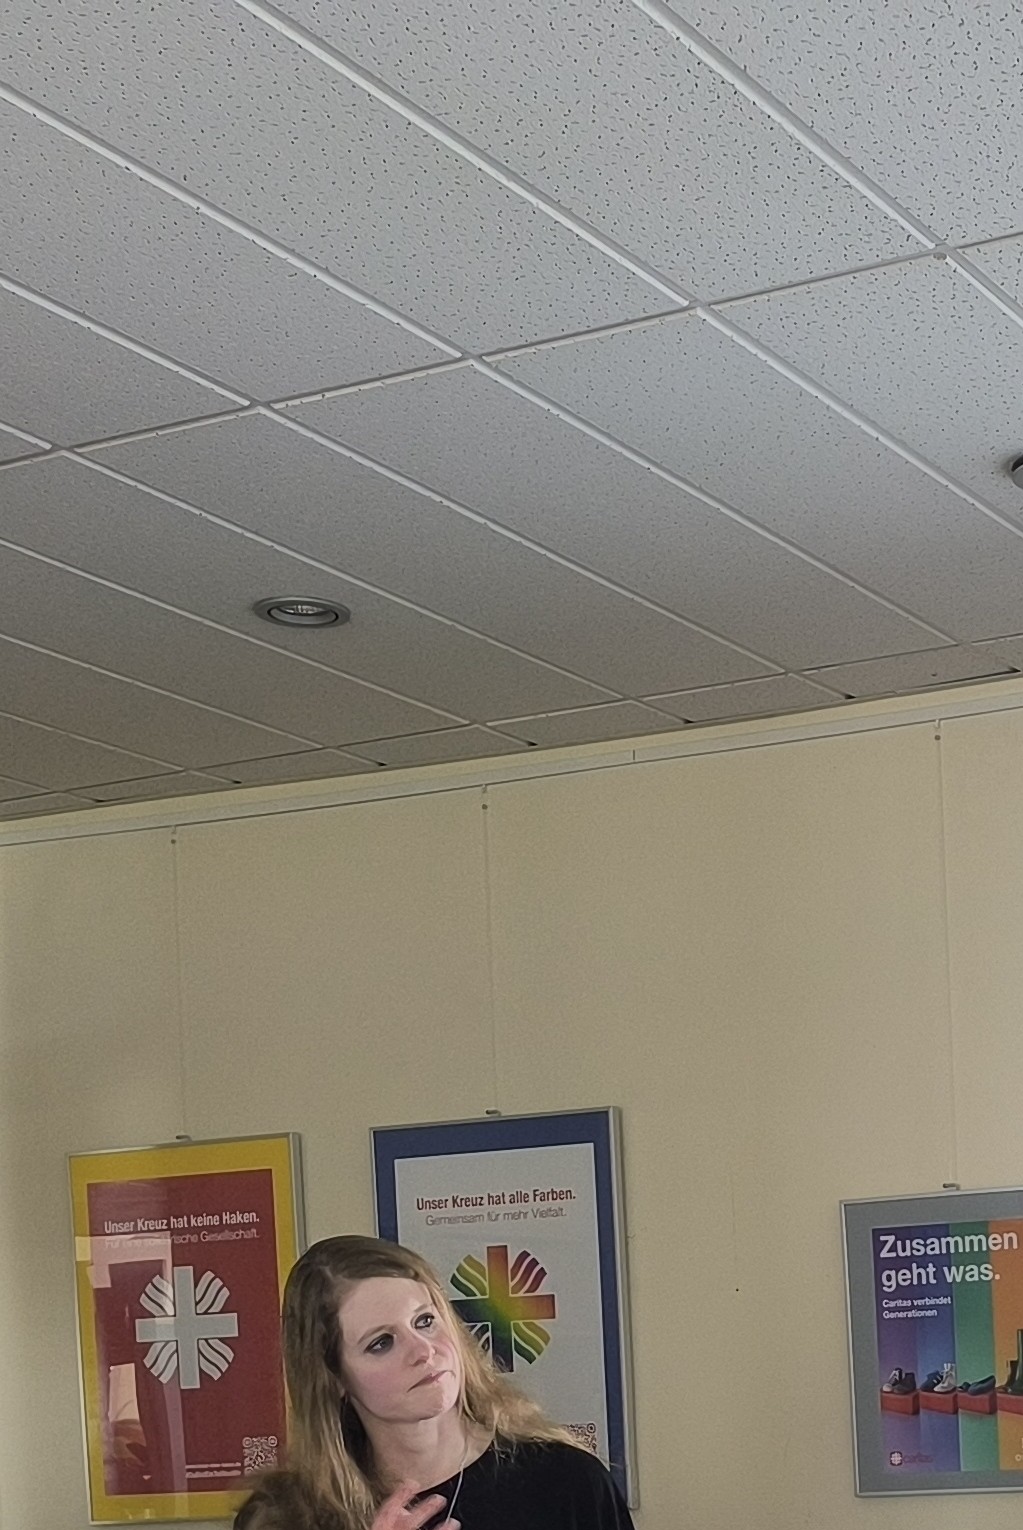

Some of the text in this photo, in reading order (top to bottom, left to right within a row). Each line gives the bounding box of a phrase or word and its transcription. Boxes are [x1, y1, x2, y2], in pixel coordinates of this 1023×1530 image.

[416, 1188, 576, 1211] Unser Kreuz hat alle Farben.
[104, 1210, 260, 1234] Unser Kreuz hat keine Haken.
[425, 1207, 567, 1226] Gemeinsam für mehr Vielfalt.
[879, 1231, 1018, 1258] Zusammen
[881, 1262, 1001, 1292] geht was.
[882, 1295, 952, 1308] Caritas verbindet
[882, 1308, 938, 1319] Generationen
